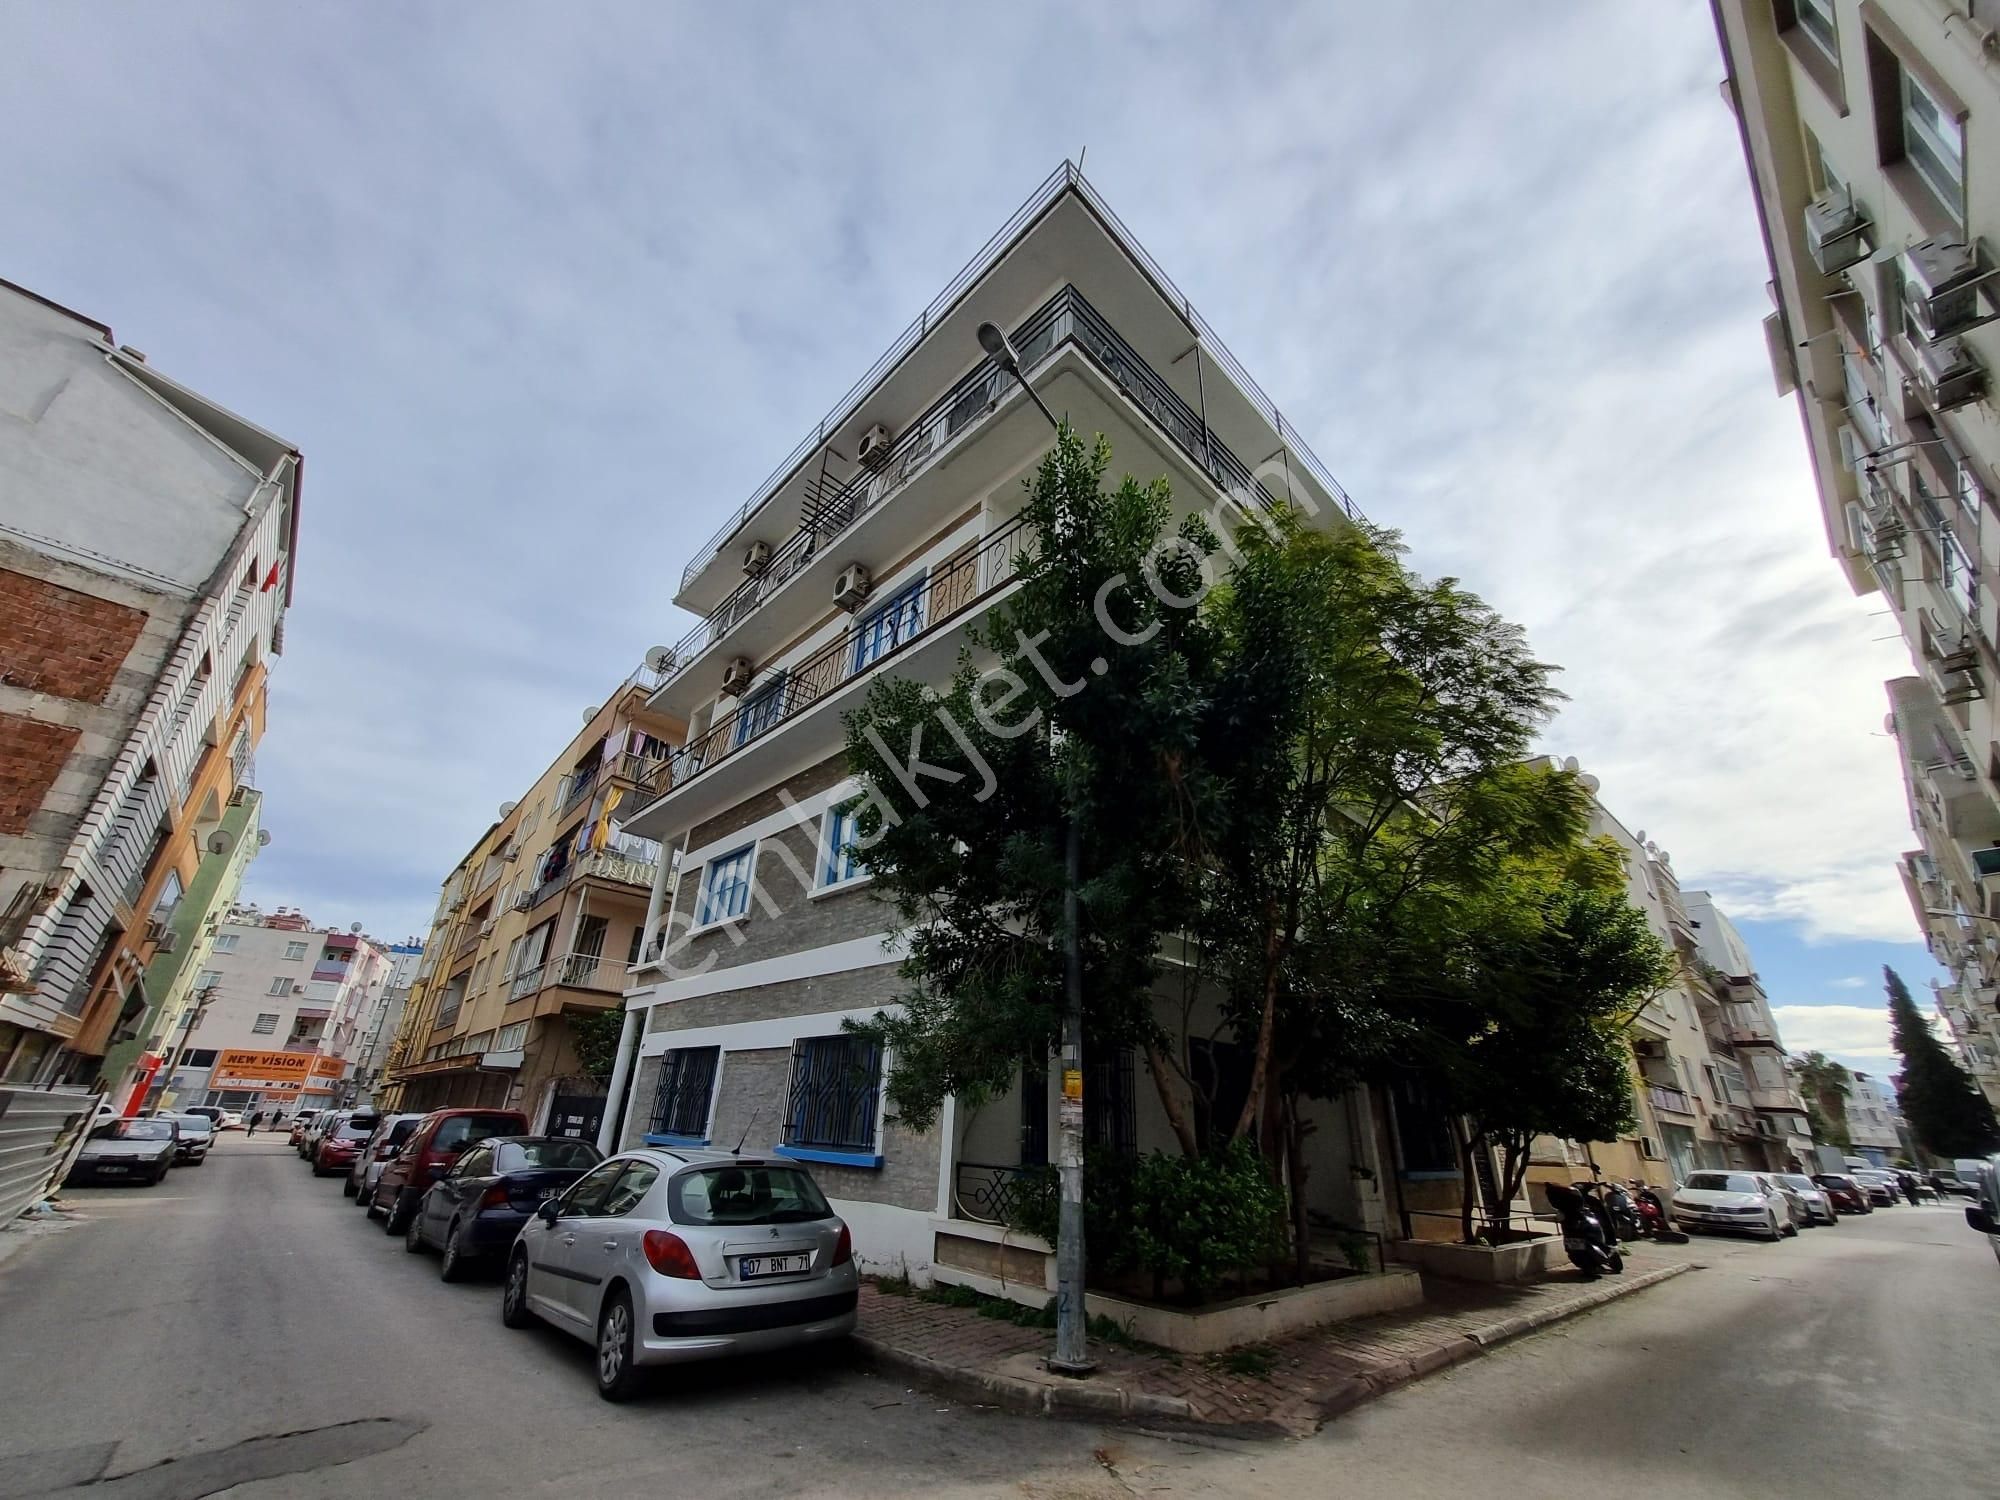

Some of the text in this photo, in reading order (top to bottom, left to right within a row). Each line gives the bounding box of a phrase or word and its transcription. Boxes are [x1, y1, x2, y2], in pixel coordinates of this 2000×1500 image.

[227, 1054, 258, 1065] NEW
[749, 1259, 761, 1274] 07
[770, 1256, 789, 1272] BNT
